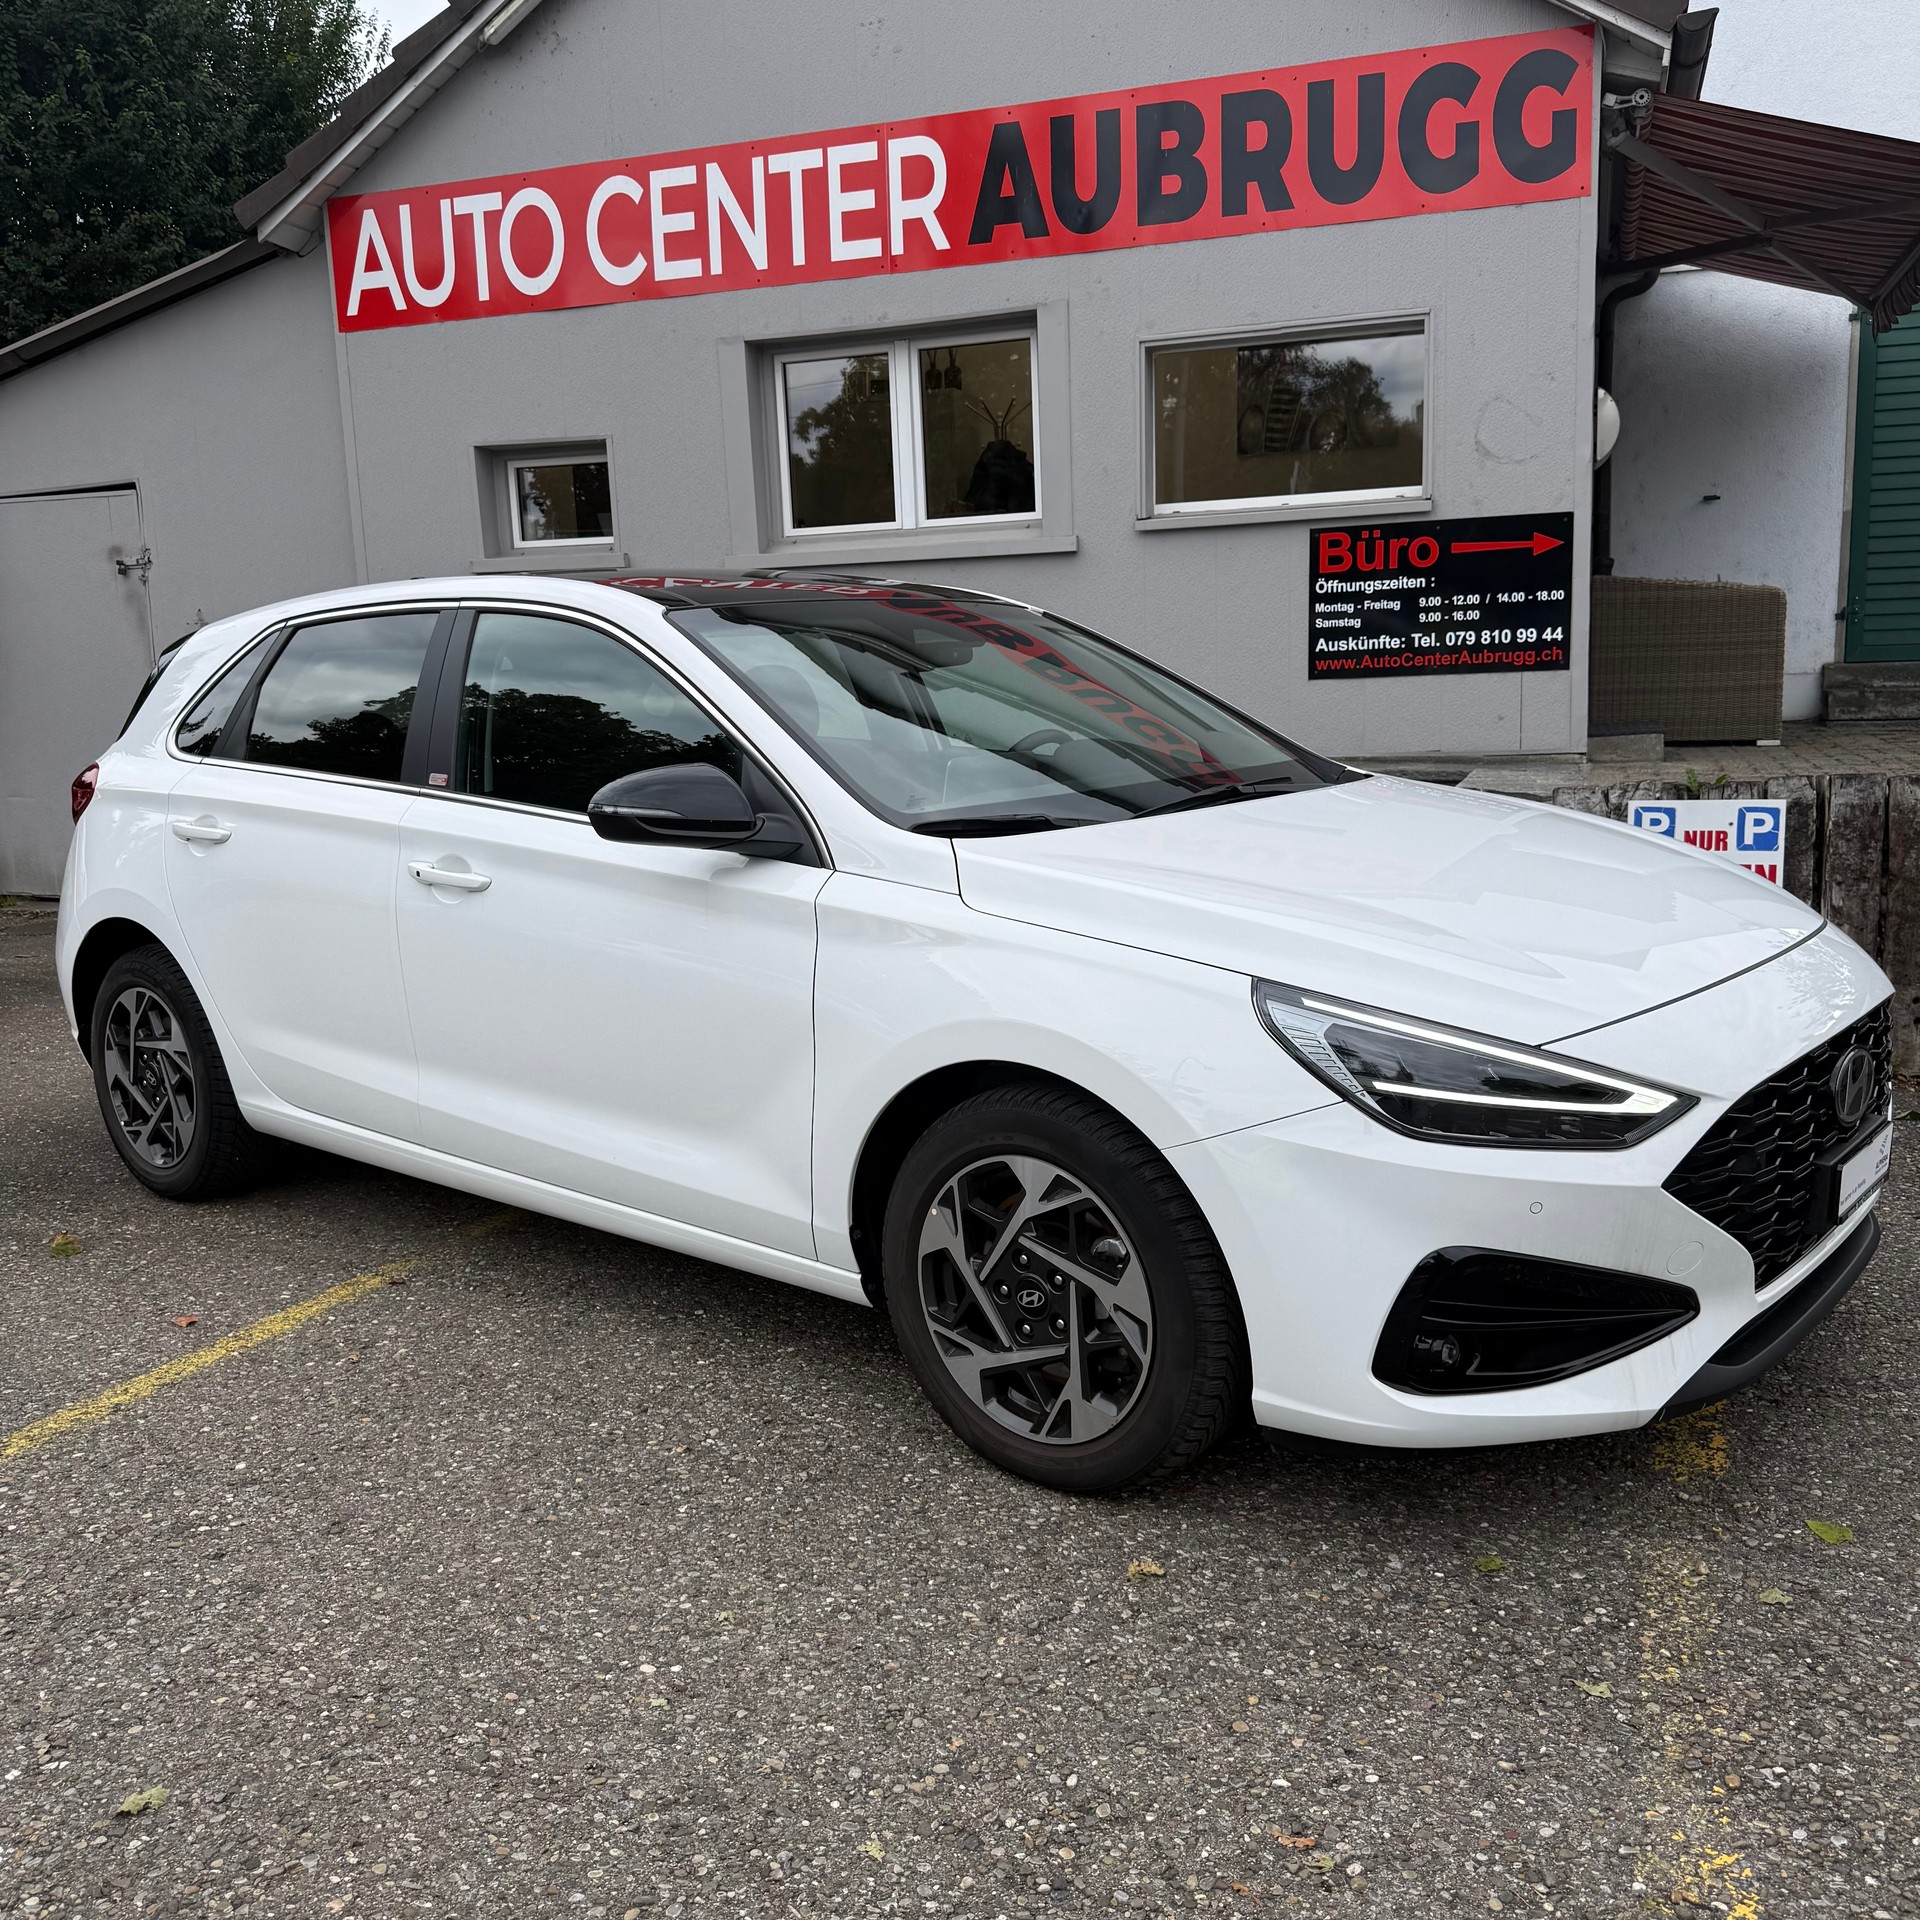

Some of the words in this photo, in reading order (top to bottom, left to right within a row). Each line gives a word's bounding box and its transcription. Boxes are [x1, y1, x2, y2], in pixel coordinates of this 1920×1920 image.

[347, 187, 565, 317] AUTO
[586, 135, 951, 286] CENTER
[968, 48, 1580, 246] AUBRUGG
[1319, 529, 1440, 574] Büro
[1315, 576, 1426, 594] Öffnungszeiten
[1315, 603, 1355, 614] Montag
[1364, 600, 1401, 611] Freitag
[1419, 596, 1442, 607] 9.00
[1452, 594, 1481, 606] 12.00
[1496, 592, 1526, 603] 14.00
[1536, 589, 1565, 601] 18.00
[1315, 618, 1361, 628] Samstag
[1419, 612, 1442, 623] 9.00
[1452, 610, 1480, 621] 16.00
[1315, 634, 1406, 653] Auskünfte:
[1411, 632, 1440, 648] Tel.
[1445, 630, 1476, 646] 079
[1480, 629, 1512, 645] 810
[1516, 627, 1538, 643] 99
[1541, 626, 1564, 642] 44
[1315, 646, 1563, 671] www.AutoCenterAubrugg.ch
[1684, 830, 1729, 852] NUR
